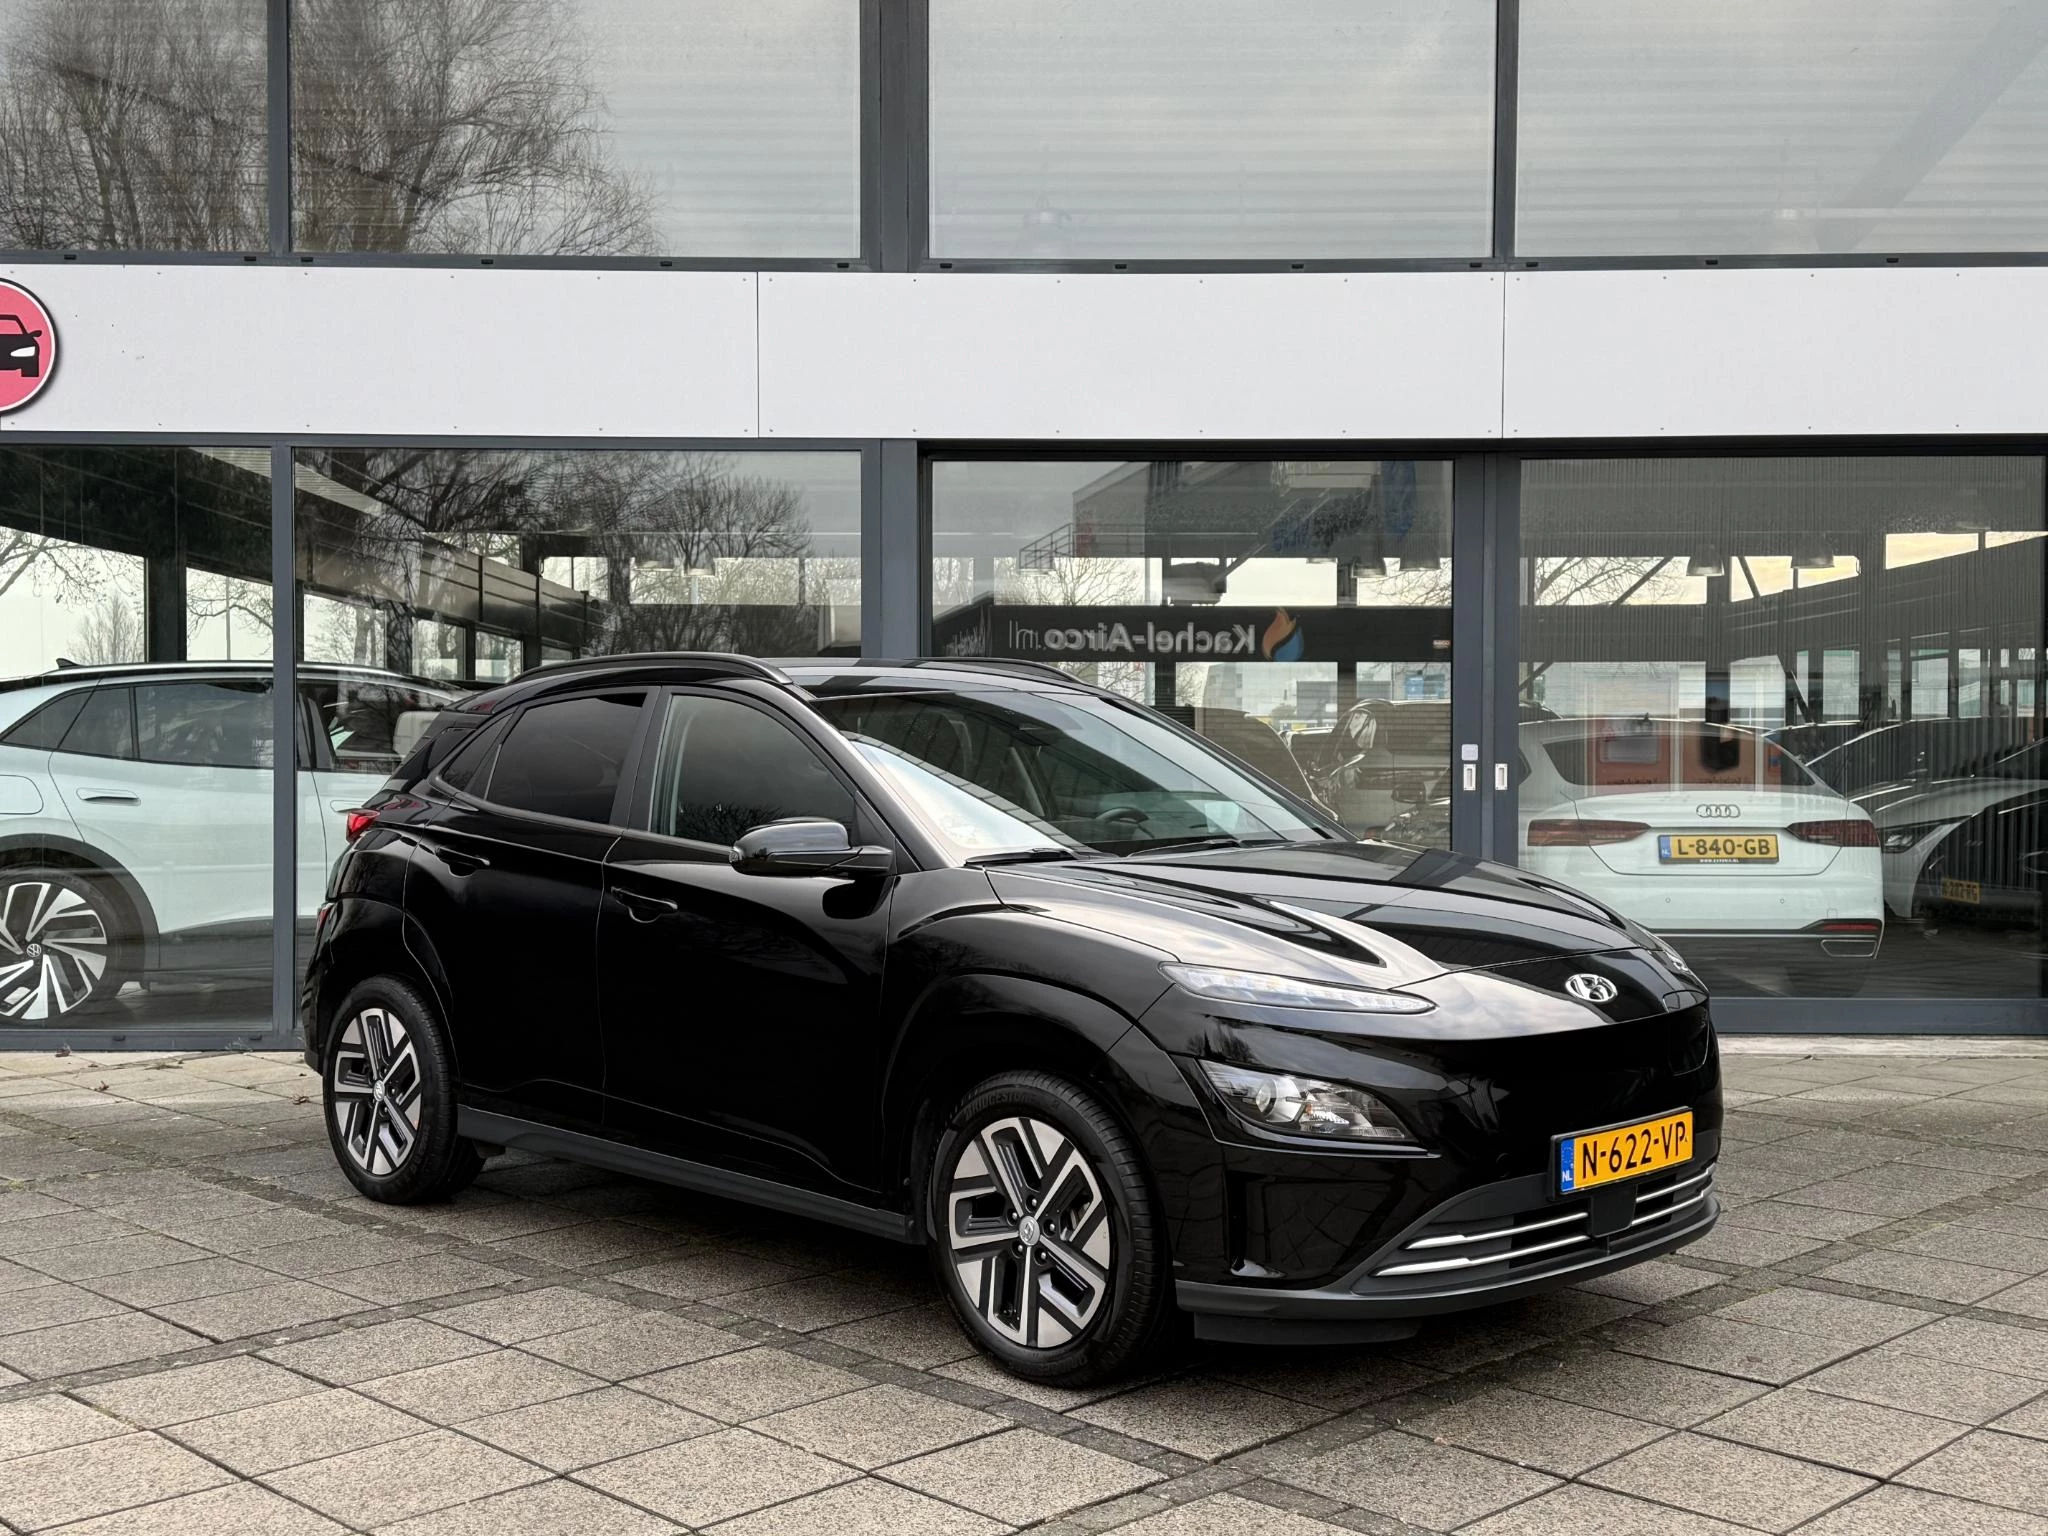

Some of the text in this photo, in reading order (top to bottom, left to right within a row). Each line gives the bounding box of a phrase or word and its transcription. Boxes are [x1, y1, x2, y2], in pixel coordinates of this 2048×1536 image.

[1677, 838, 1770, 855] L-840-GB
[1582, 1121, 1686, 1180] N-622-VP
[1562, 1170, 1573, 1183] NL
